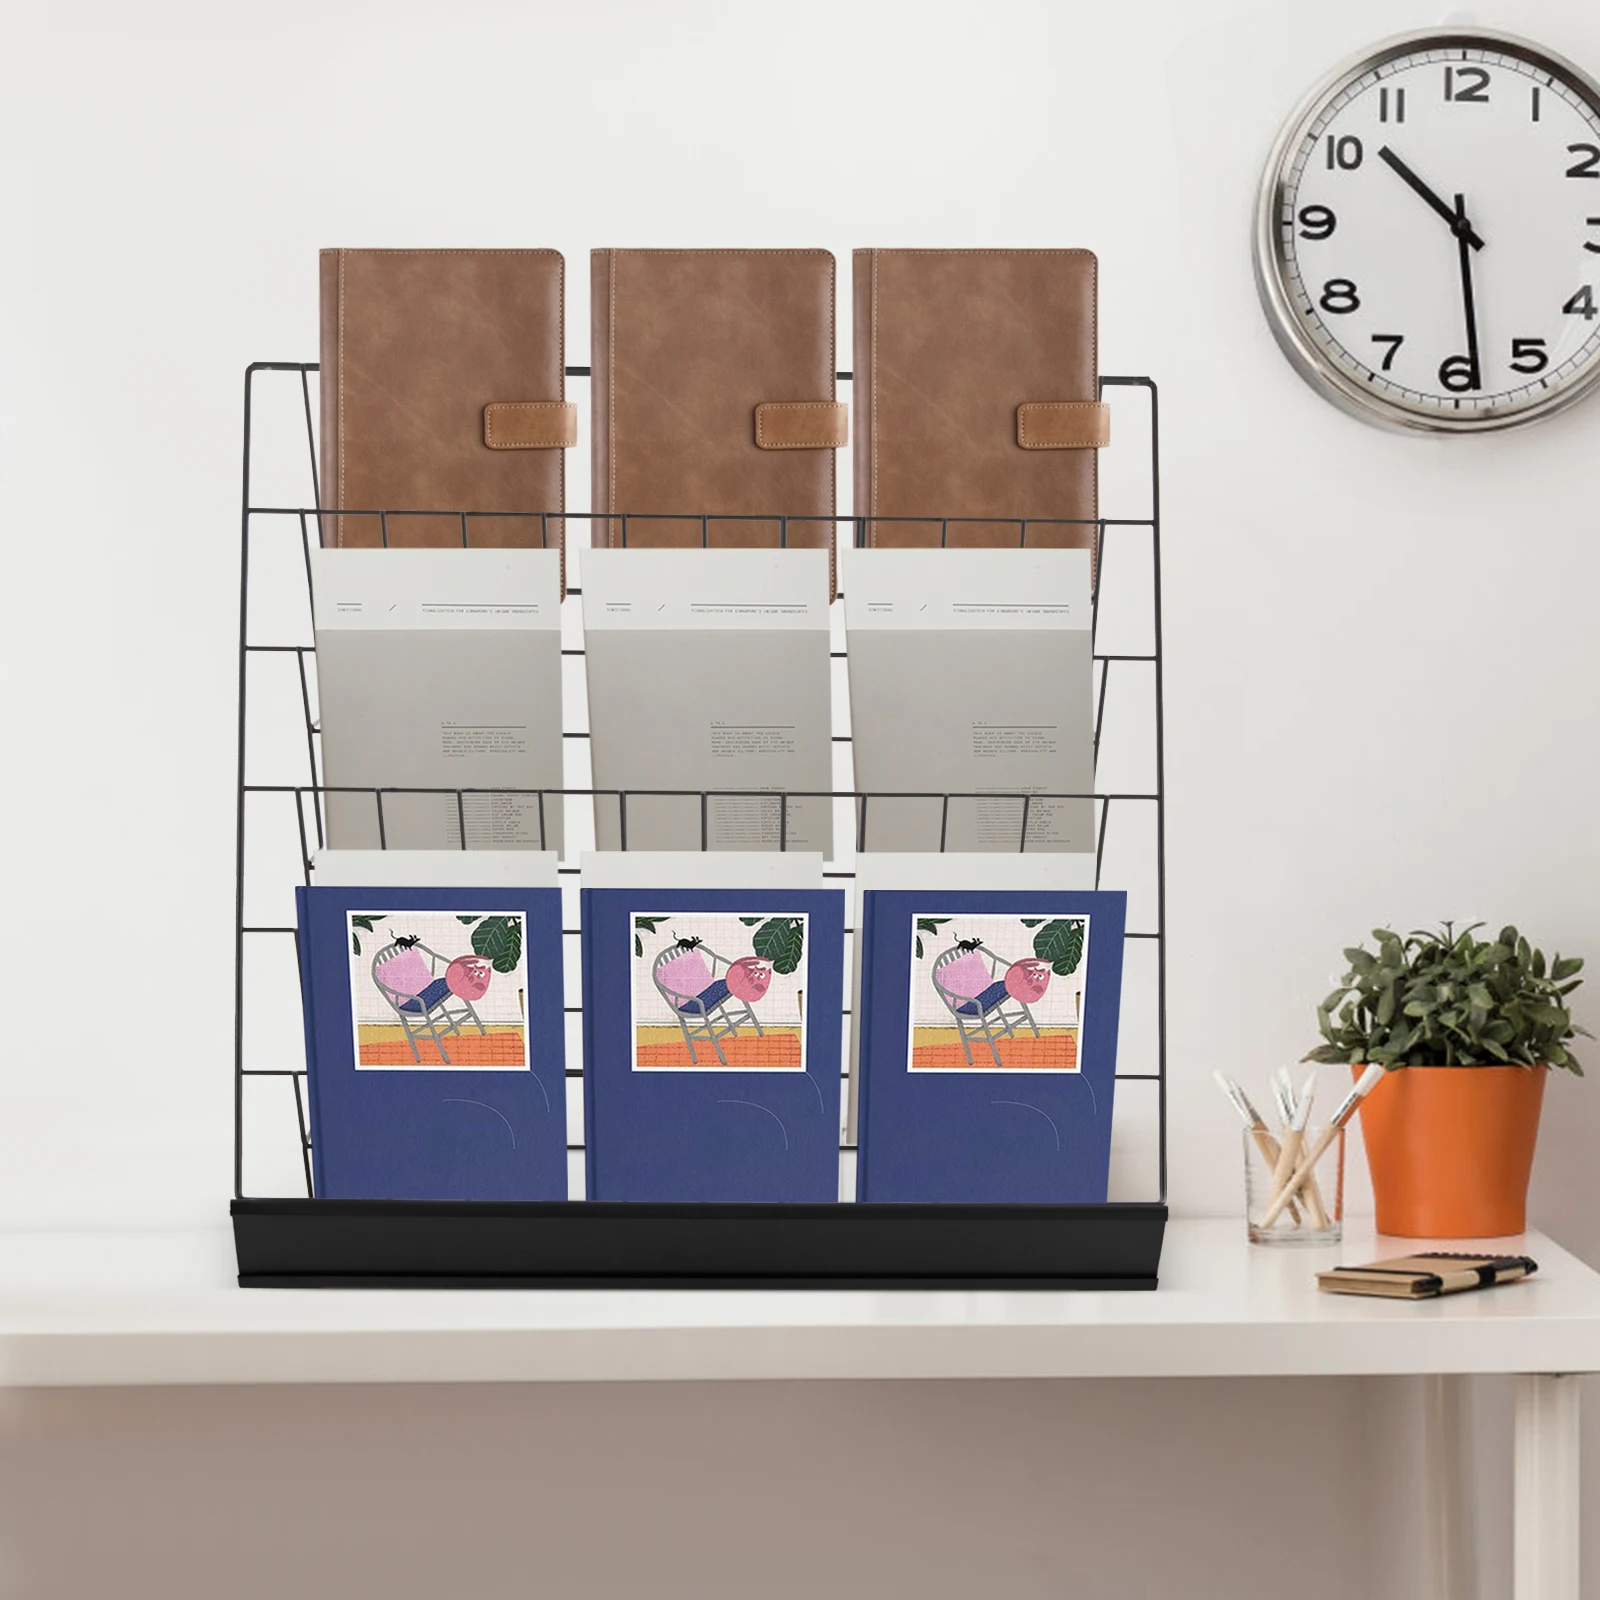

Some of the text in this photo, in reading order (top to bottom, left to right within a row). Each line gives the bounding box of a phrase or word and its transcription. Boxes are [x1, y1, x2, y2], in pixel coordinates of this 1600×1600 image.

[1444, 66, 1491, 103] 12
[1379, 87, 1405, 124] 11
[1531, 86, 1540, 122] 1
[1326, 134, 1364, 171] 10
[1565, 143, 1600, 179] 2
[1297, 204, 1337, 241] 9
[1318, 278, 1361, 315] 8
[1561, 284, 1599, 321] 4
[1370, 333, 1405, 372] 7
[1508, 337, 1549, 375] 5
[1438, 355, 1475, 393] 6
